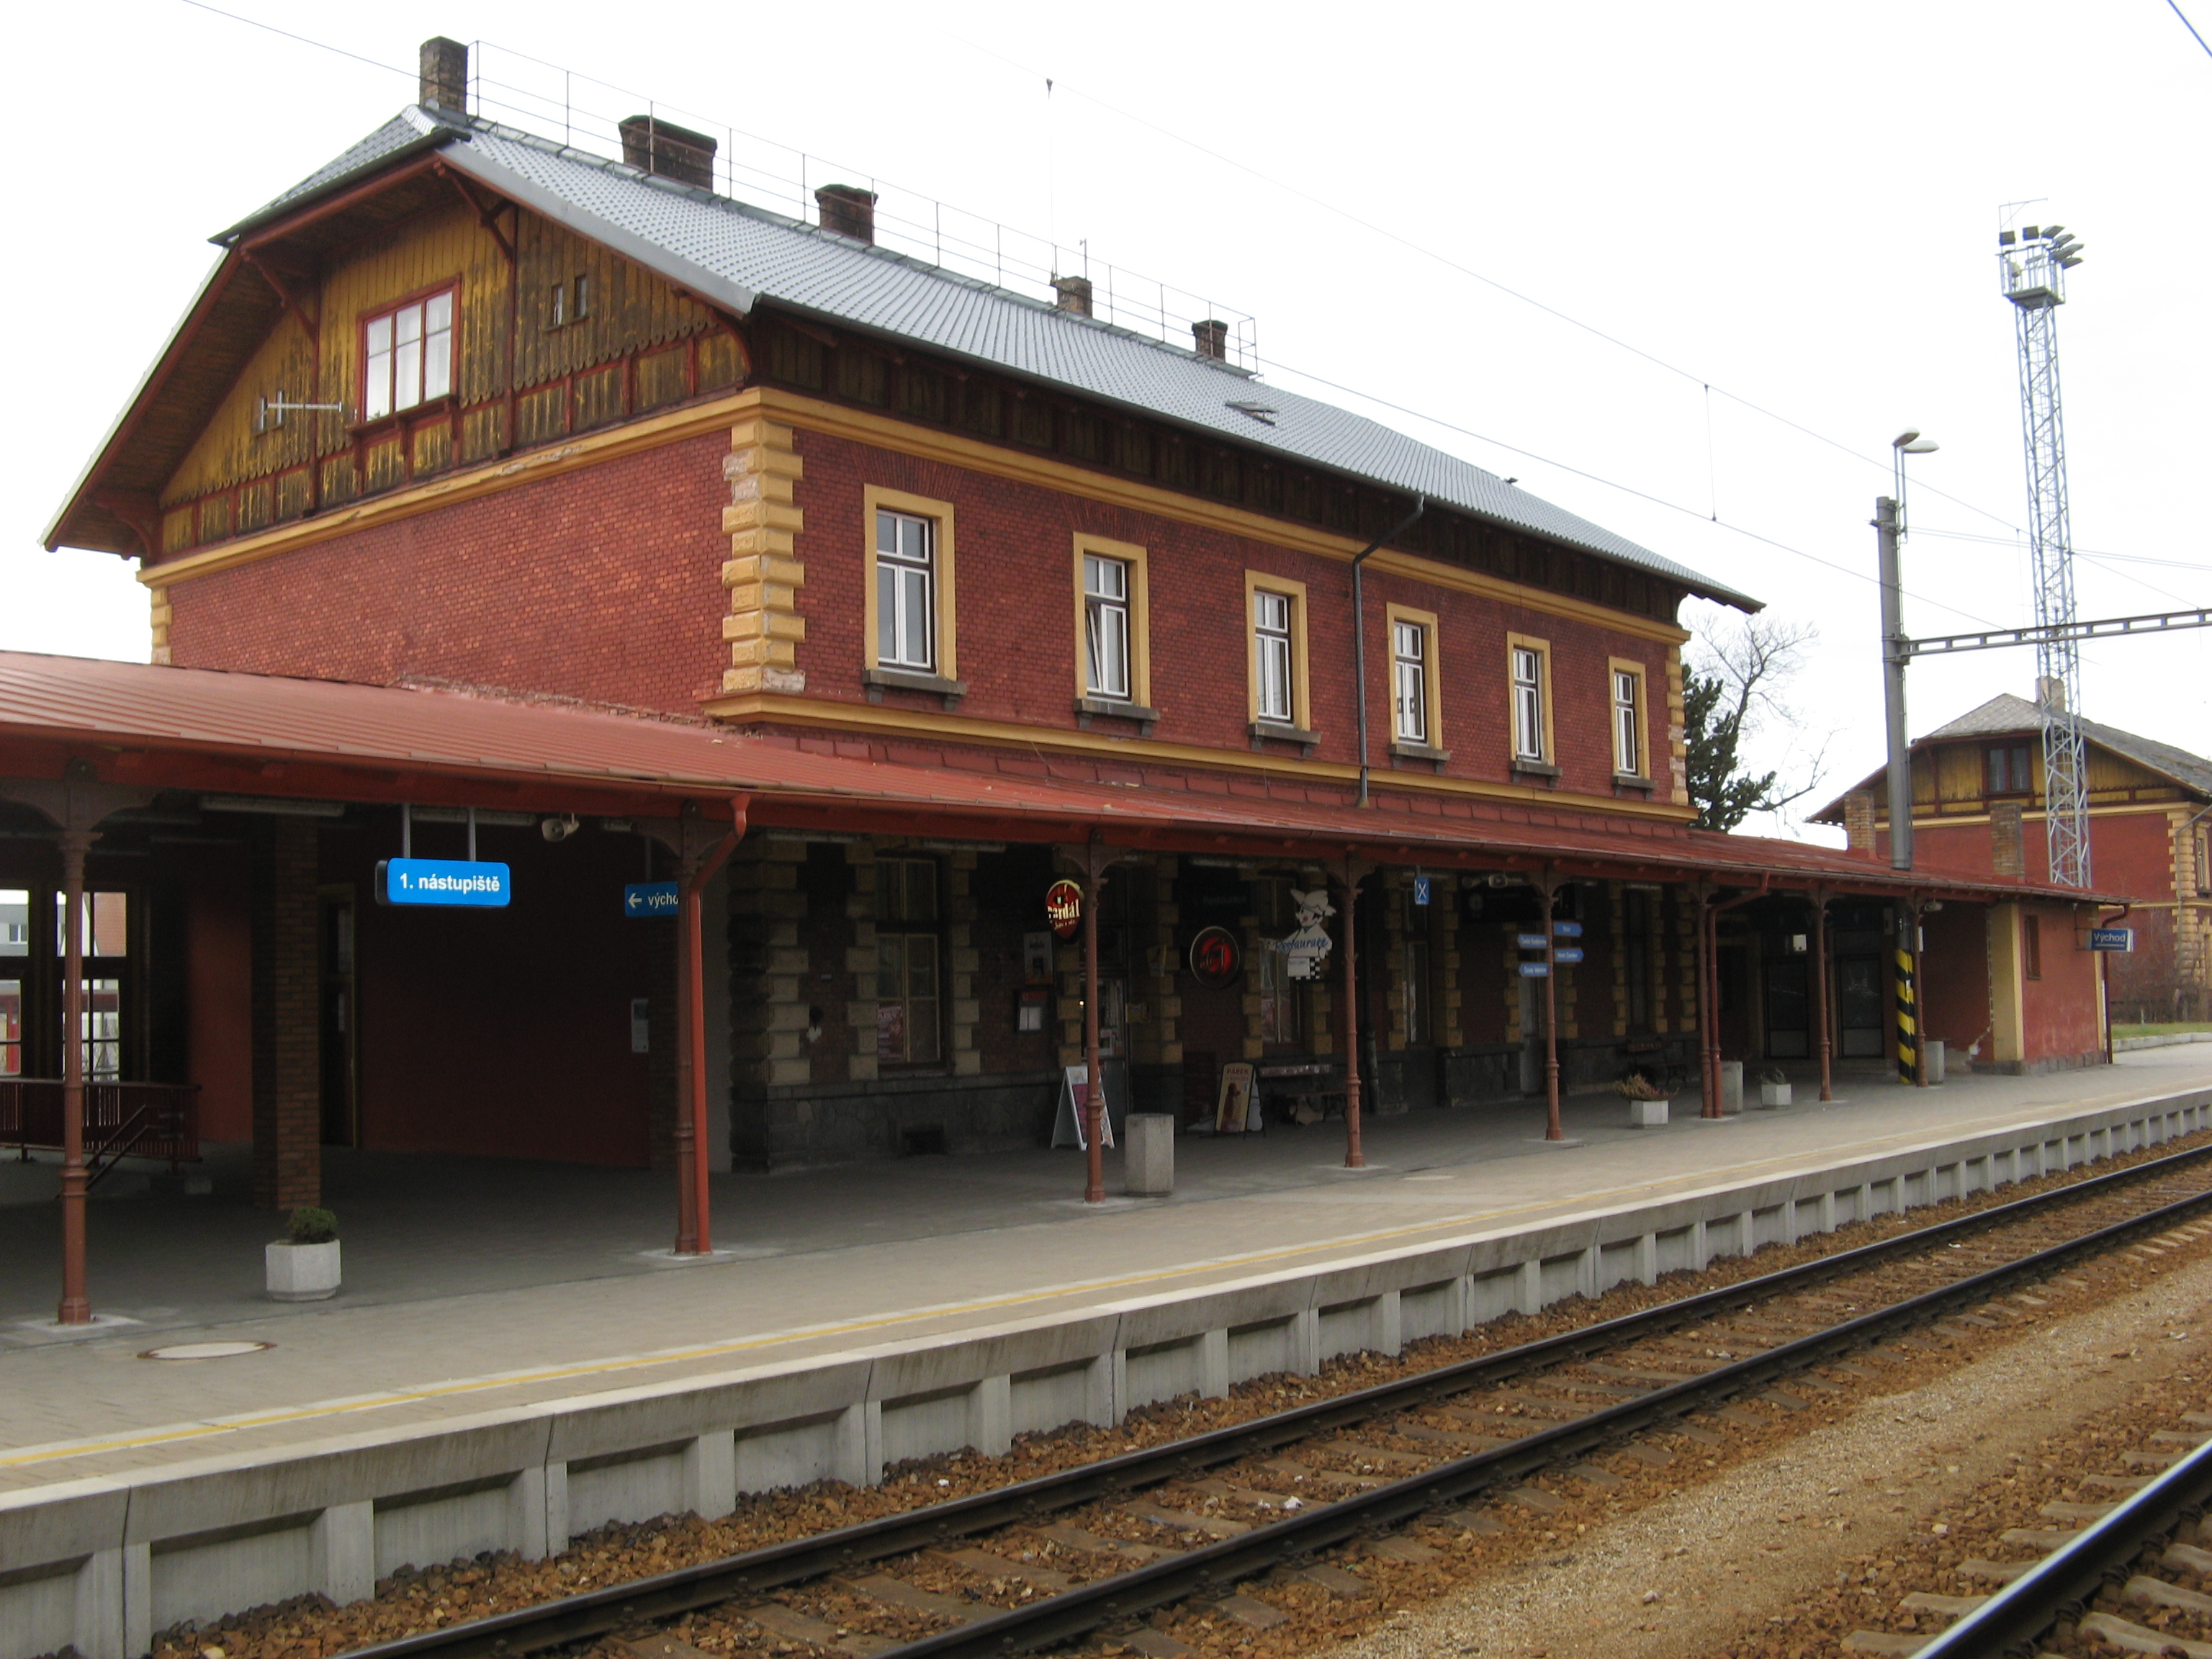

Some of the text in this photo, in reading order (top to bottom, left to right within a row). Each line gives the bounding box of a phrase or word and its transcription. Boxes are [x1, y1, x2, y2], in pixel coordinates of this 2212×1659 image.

[399, 872, 501, 895] 1. nástupiště
[647, 892, 679, 909] výcho
[2093, 932, 2126, 944] Východ
